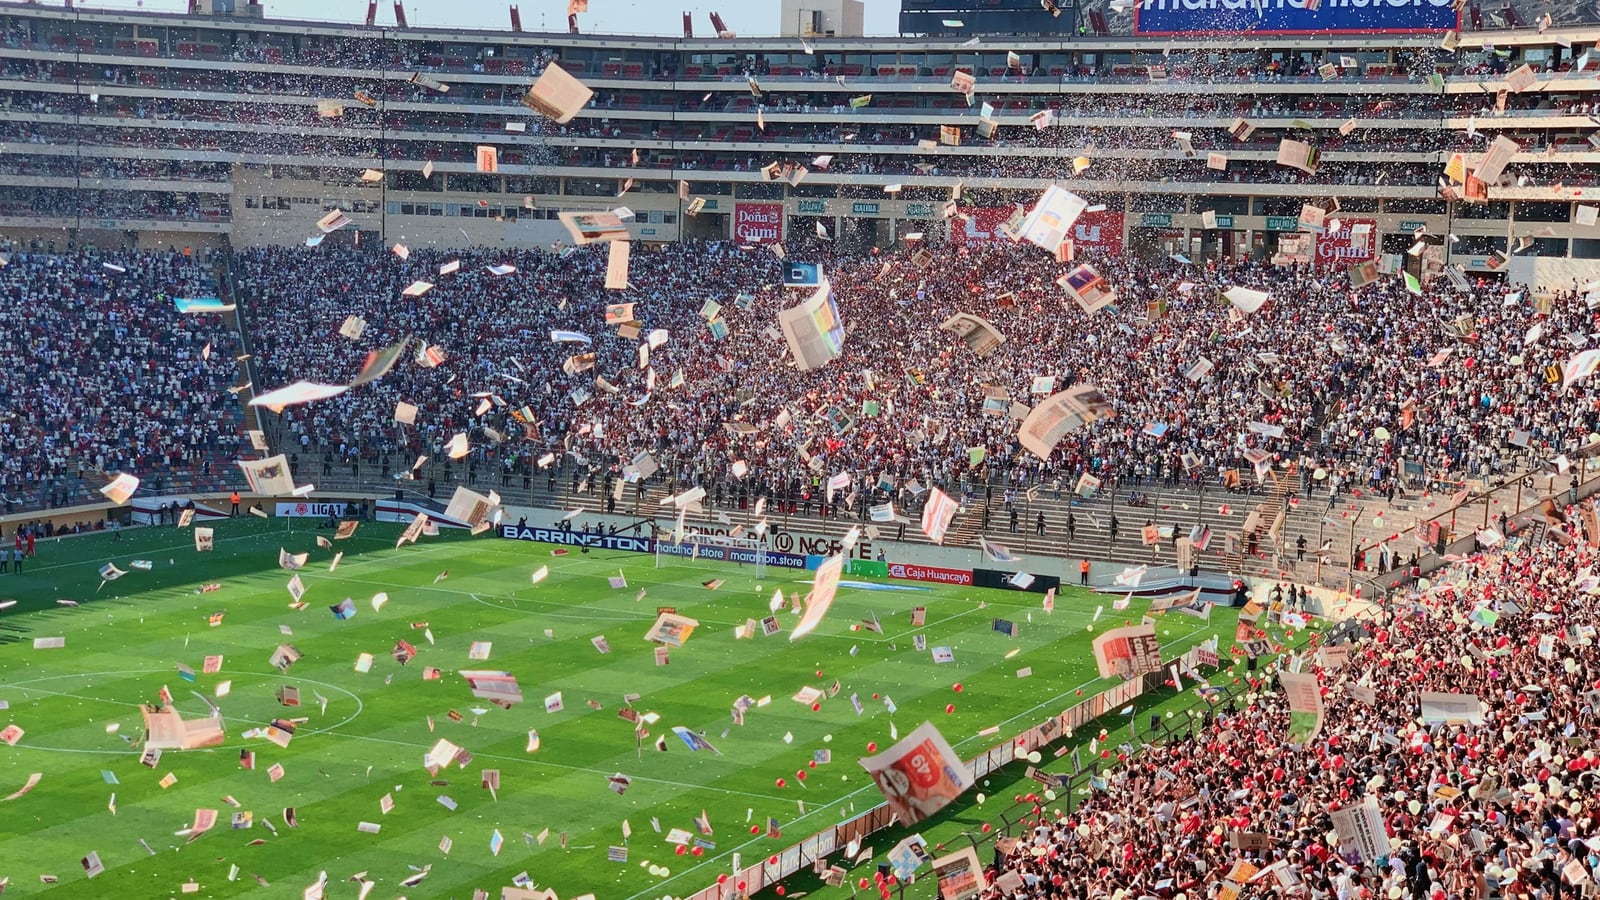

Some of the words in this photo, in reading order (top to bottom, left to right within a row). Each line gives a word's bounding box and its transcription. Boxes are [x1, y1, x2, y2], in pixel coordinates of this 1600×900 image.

[739, 208, 768, 223] Doña
[854, 204, 877, 213] SALIDA
[737, 224, 778, 239] Gumi
[503, 525, 649, 552] BARRINGTON
[907, 567, 926, 579] Caja
[927, 569, 970, 584] Huancayo
